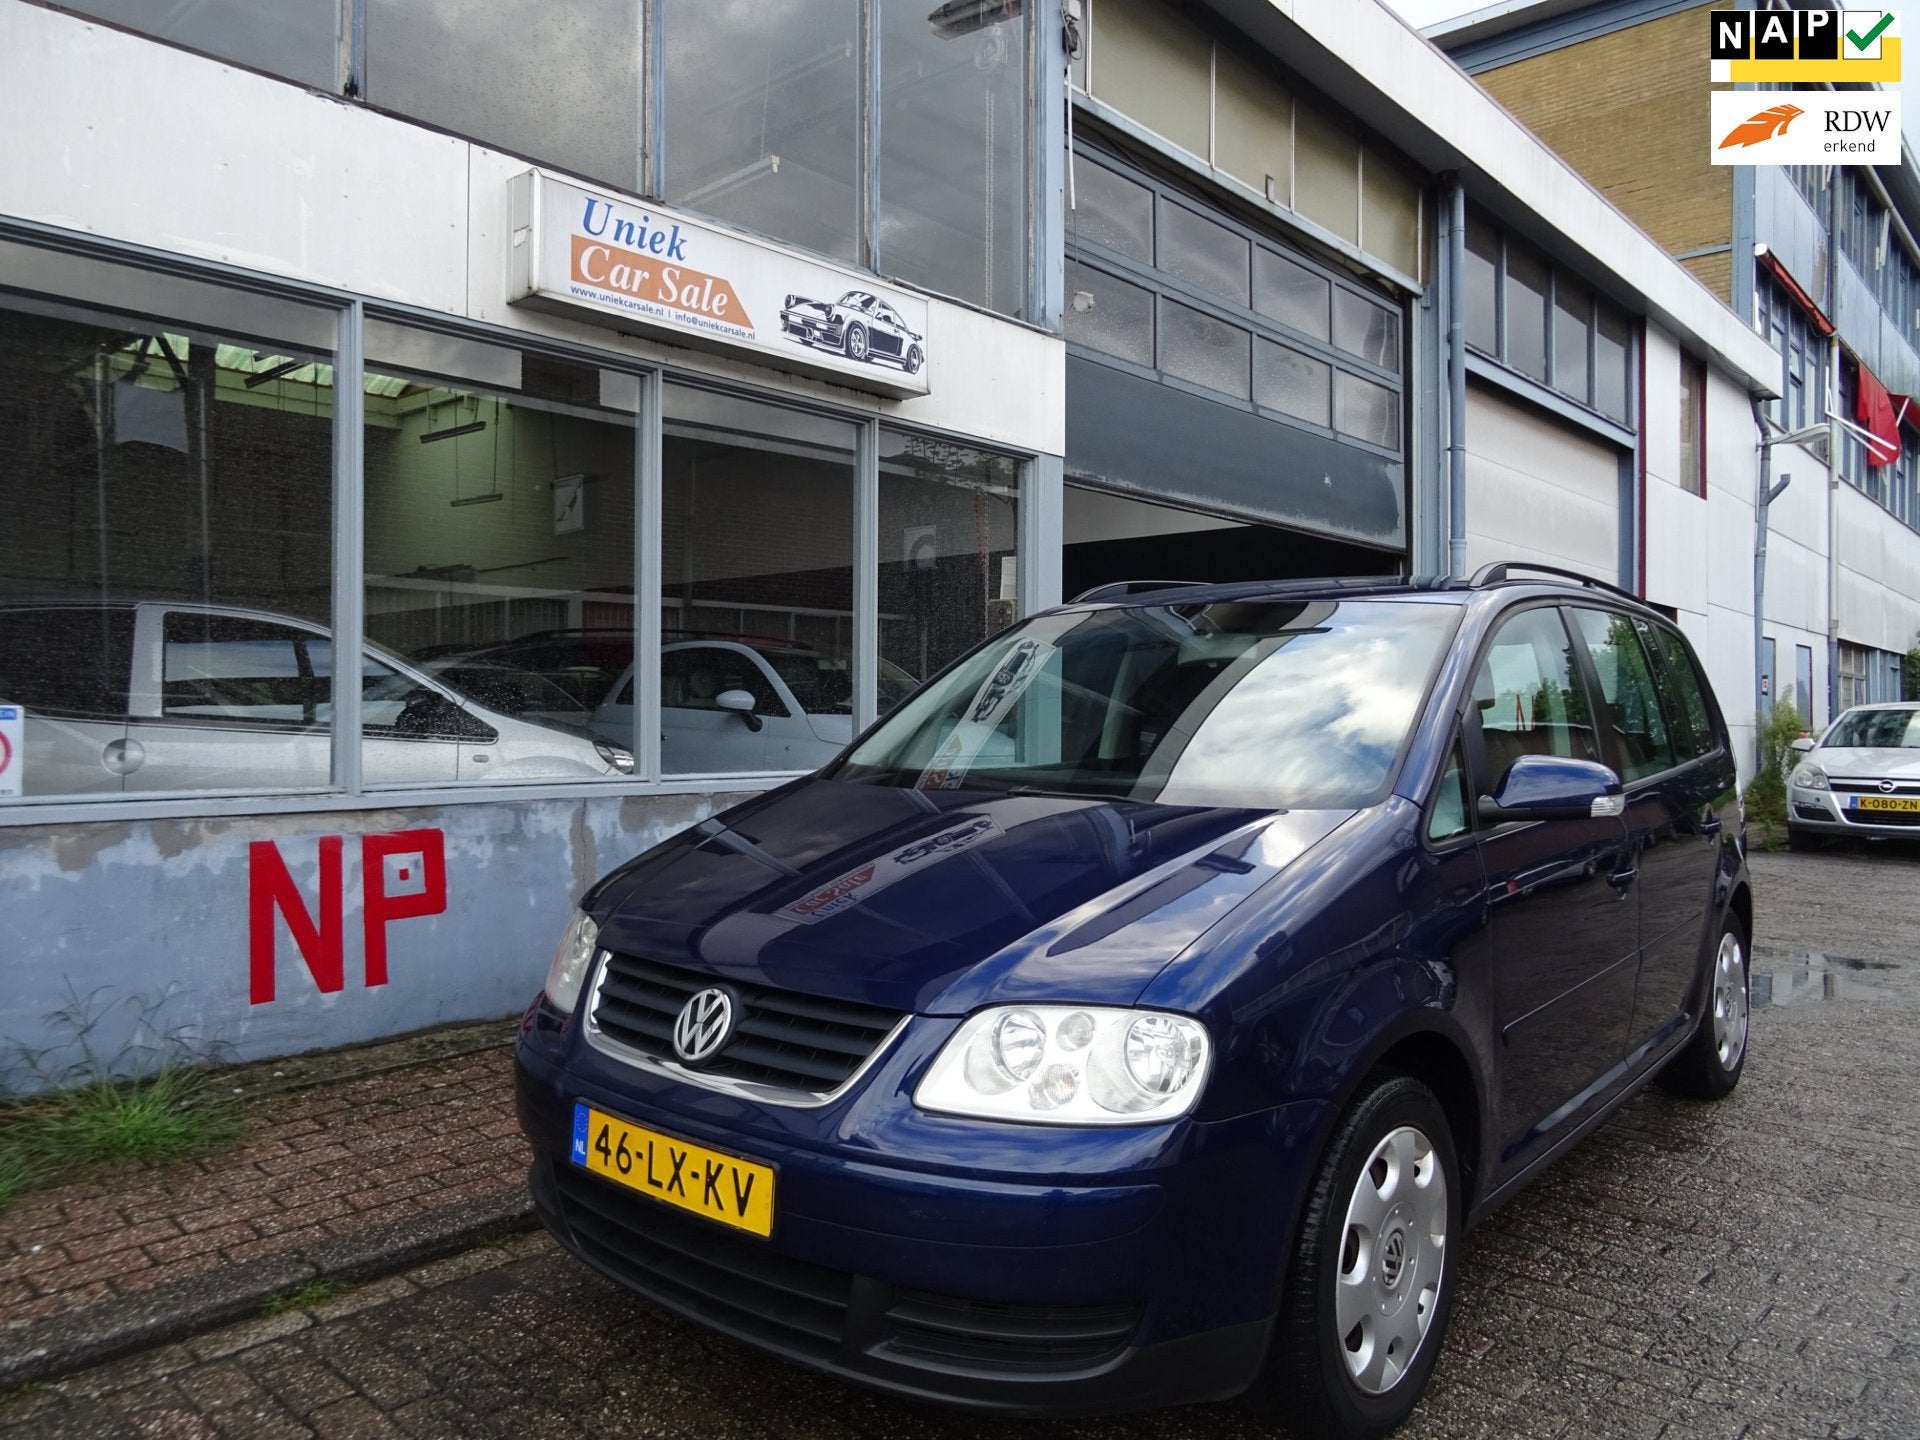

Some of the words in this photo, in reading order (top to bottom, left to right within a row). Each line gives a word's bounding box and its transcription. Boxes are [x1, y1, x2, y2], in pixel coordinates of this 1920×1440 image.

[583, 197, 687, 261] Uniek
[570, 285, 664, 316] www.uniekcarsale.nl
[675, 311, 756, 341] info@uniekcarsale.nl
[579, 245, 650, 294] Car
[657, 266, 729, 316] Sale
[1860, 798, 1918, 810] K-080-ZN
[250, 828, 447, 1005] NP
[595, 1124, 755, 1217] 46-LX-KV
